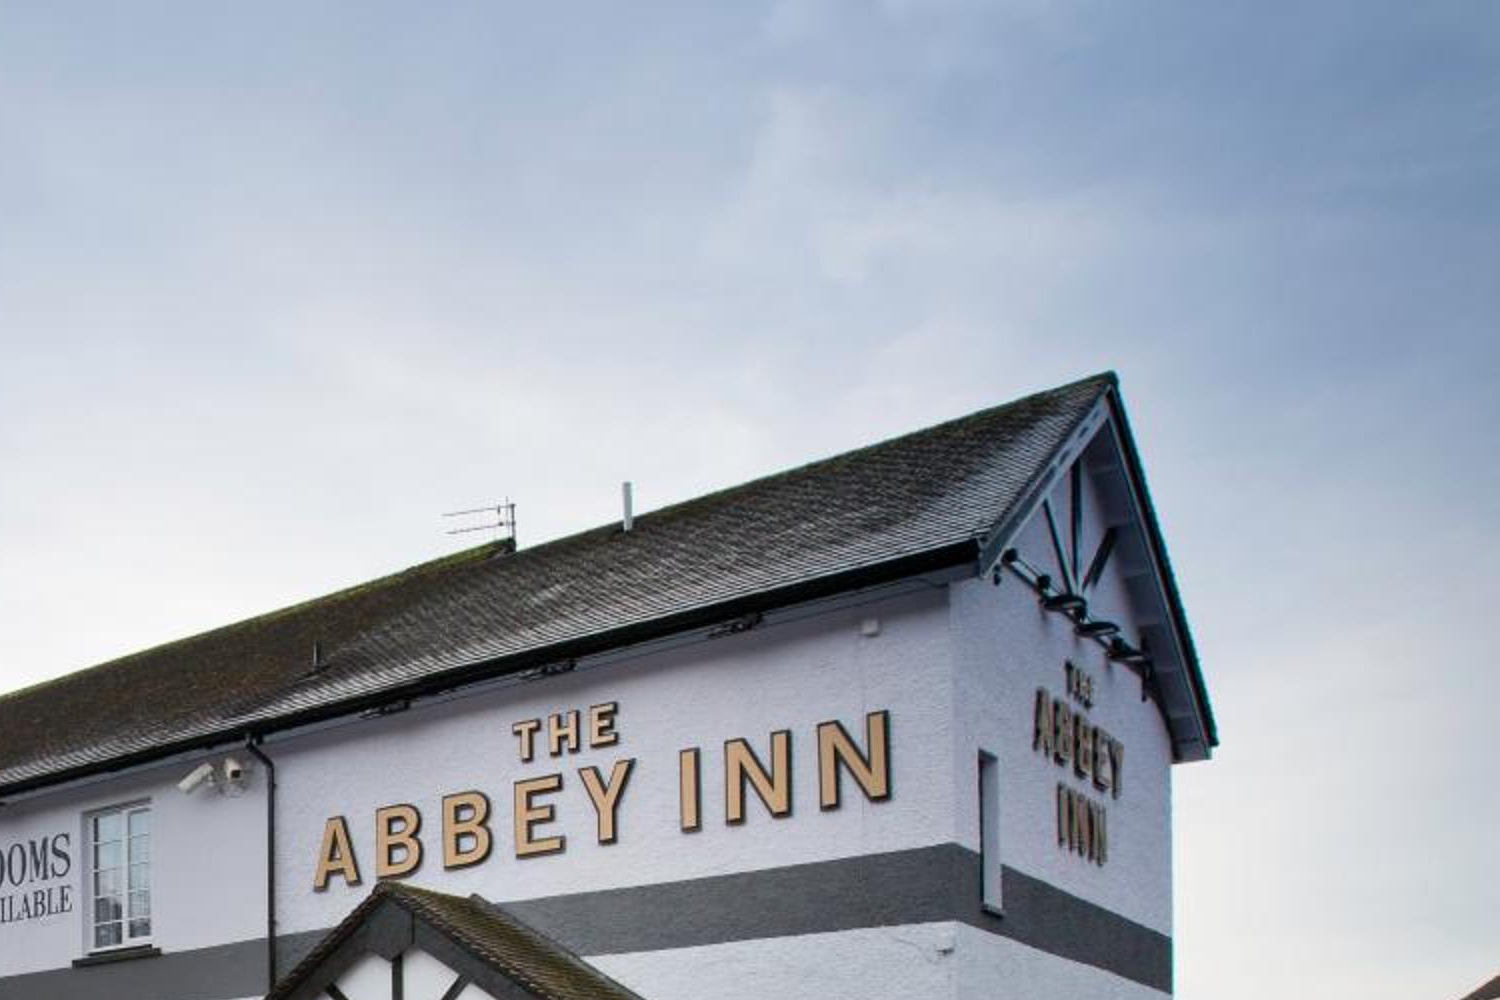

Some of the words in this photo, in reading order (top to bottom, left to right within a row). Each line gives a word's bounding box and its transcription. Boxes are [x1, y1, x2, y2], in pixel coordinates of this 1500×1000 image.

[1064, 660, 1093, 709] THE
[512, 700, 619, 763] THE
[1033, 686, 1125, 800] ABBEY
[313, 758, 637, 891] ABBEY
[679, 709, 891, 833] INN
[1057, 778, 1108, 868] INN
